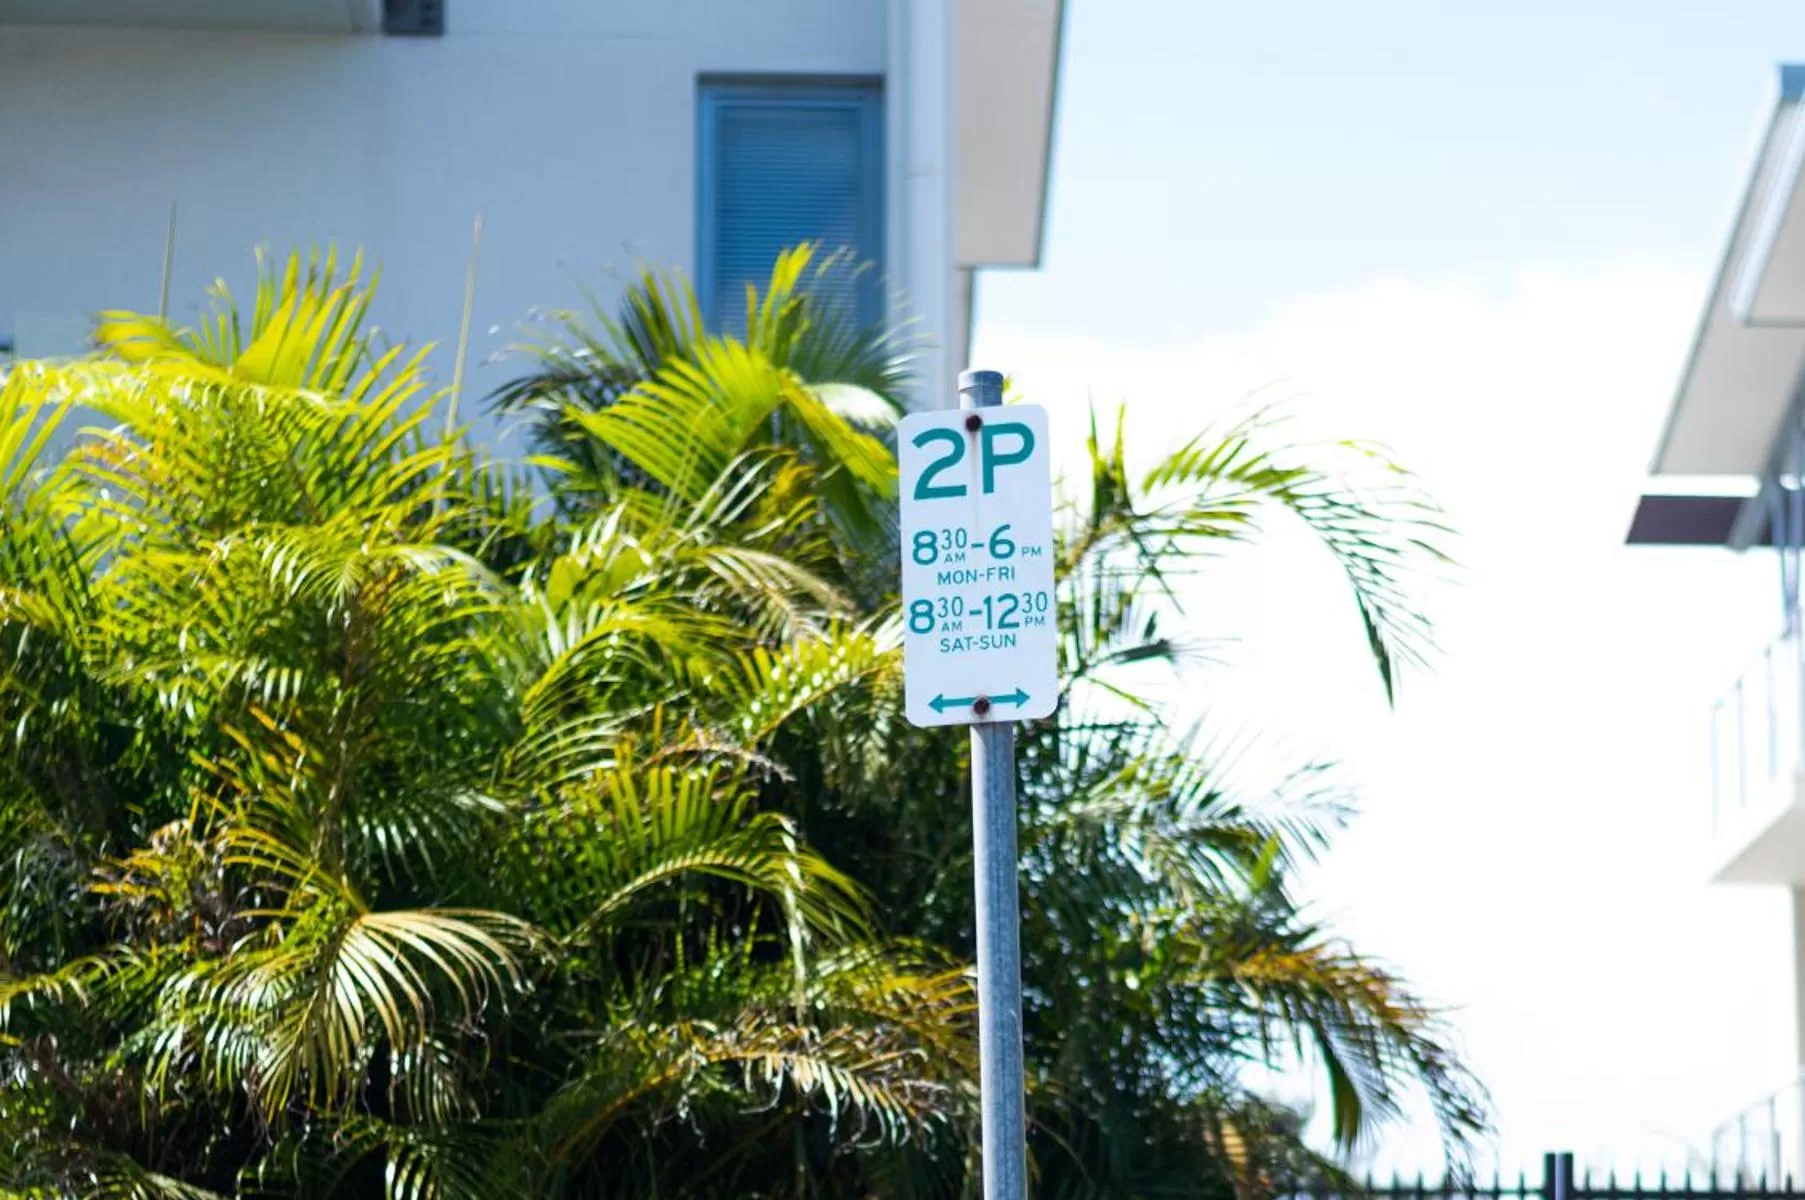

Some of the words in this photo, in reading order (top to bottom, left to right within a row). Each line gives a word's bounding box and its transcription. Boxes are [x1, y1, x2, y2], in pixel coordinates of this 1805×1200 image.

[911, 421, 1036, 501] 2P
[944, 553, 966, 564] AM
[1021, 546, 1043, 558] PM
[937, 566, 1016, 586] MON-FRI
[941, 621, 963, 633] AM
[1024, 615, 1046, 628] PM
[940, 633, 1017, 654] SAT-SUN
